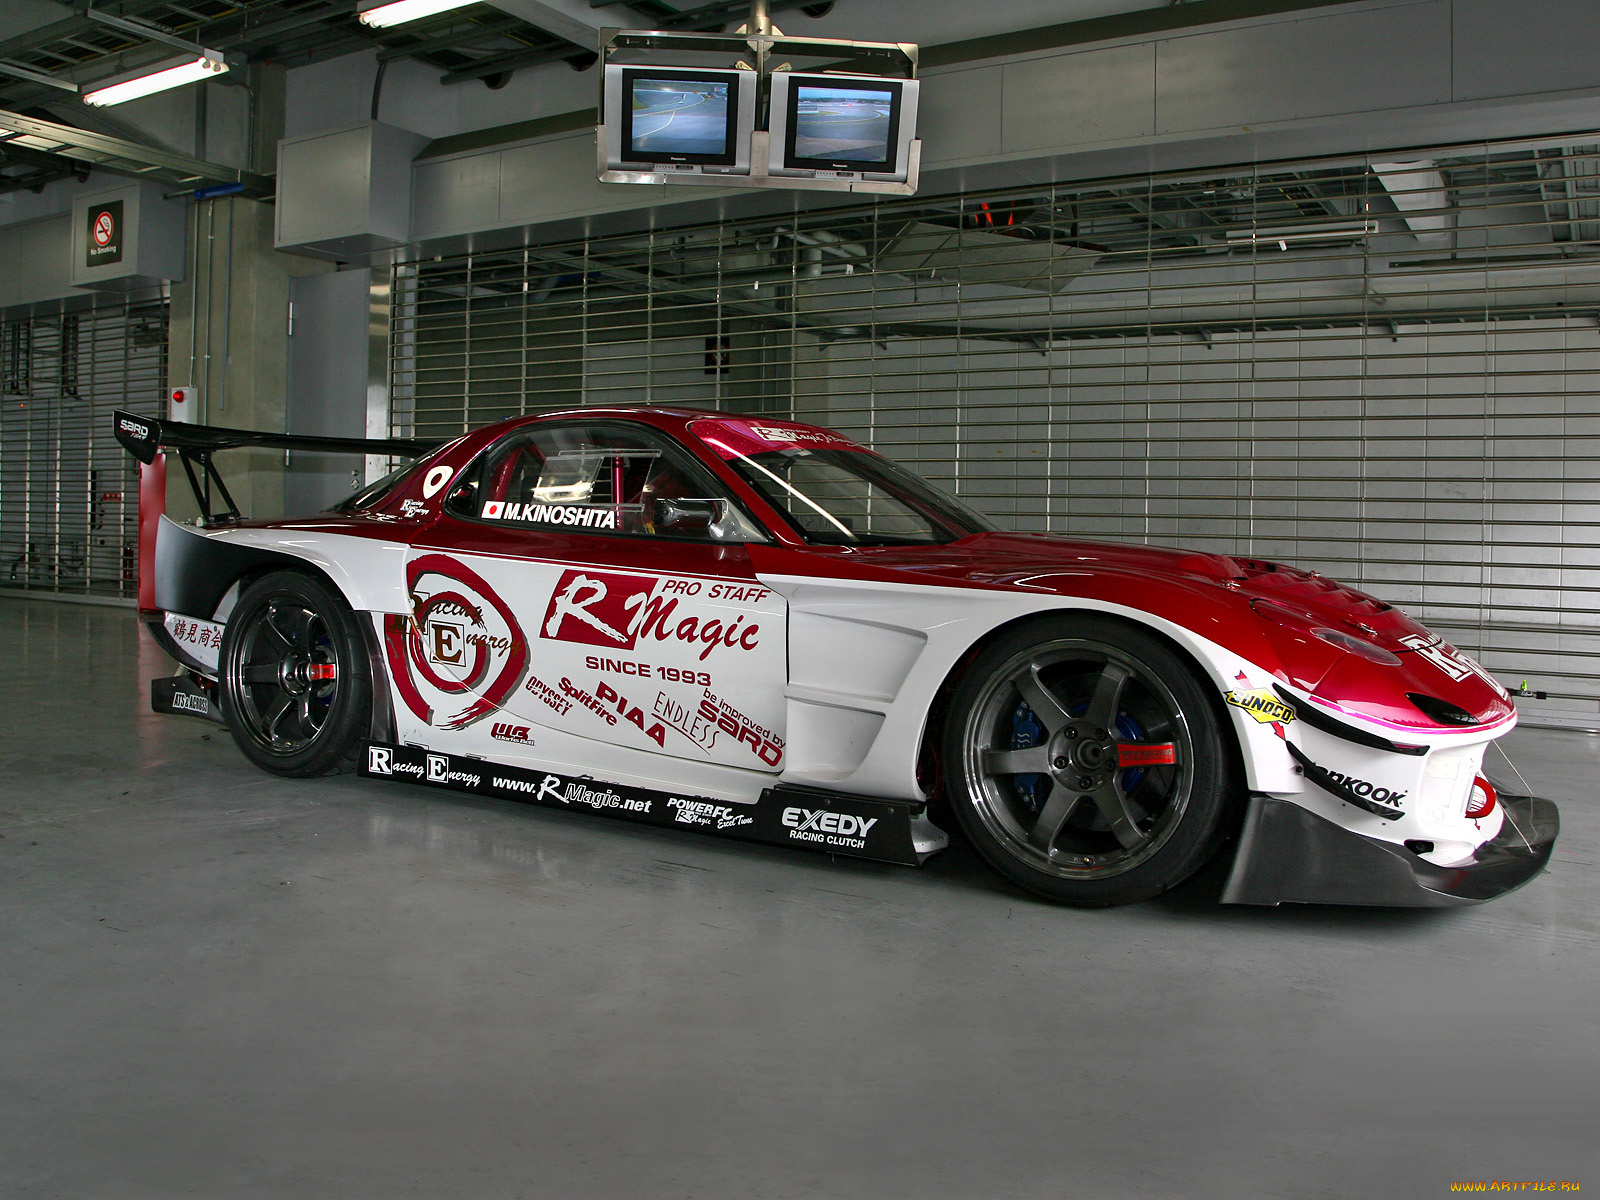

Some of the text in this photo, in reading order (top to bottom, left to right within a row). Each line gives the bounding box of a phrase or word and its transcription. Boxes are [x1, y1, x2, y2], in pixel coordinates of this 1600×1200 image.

[90, 245, 117, 256] No Smoking
[503, 502, 615, 529] M.KINOSHITA
[662, 579, 771, 603] PRO STAFF
[546, 574, 760, 661] R Magic
[585, 656, 711, 687] SINCE 1993
[525, 676, 574, 716] ODYSSEY
[558, 677, 618, 726] SplitFire
[1229, 689, 1292, 722] SUNOCO
[595, 681, 666, 749] PIAA
[653, 691, 720, 749] ENDLESS
[703, 688, 787, 749] be improved by
[369, 747, 481, 787] Racing Energy
[781, 806, 878, 837] EXEDY
[789, 829, 865, 849] RACING CLUTCH
